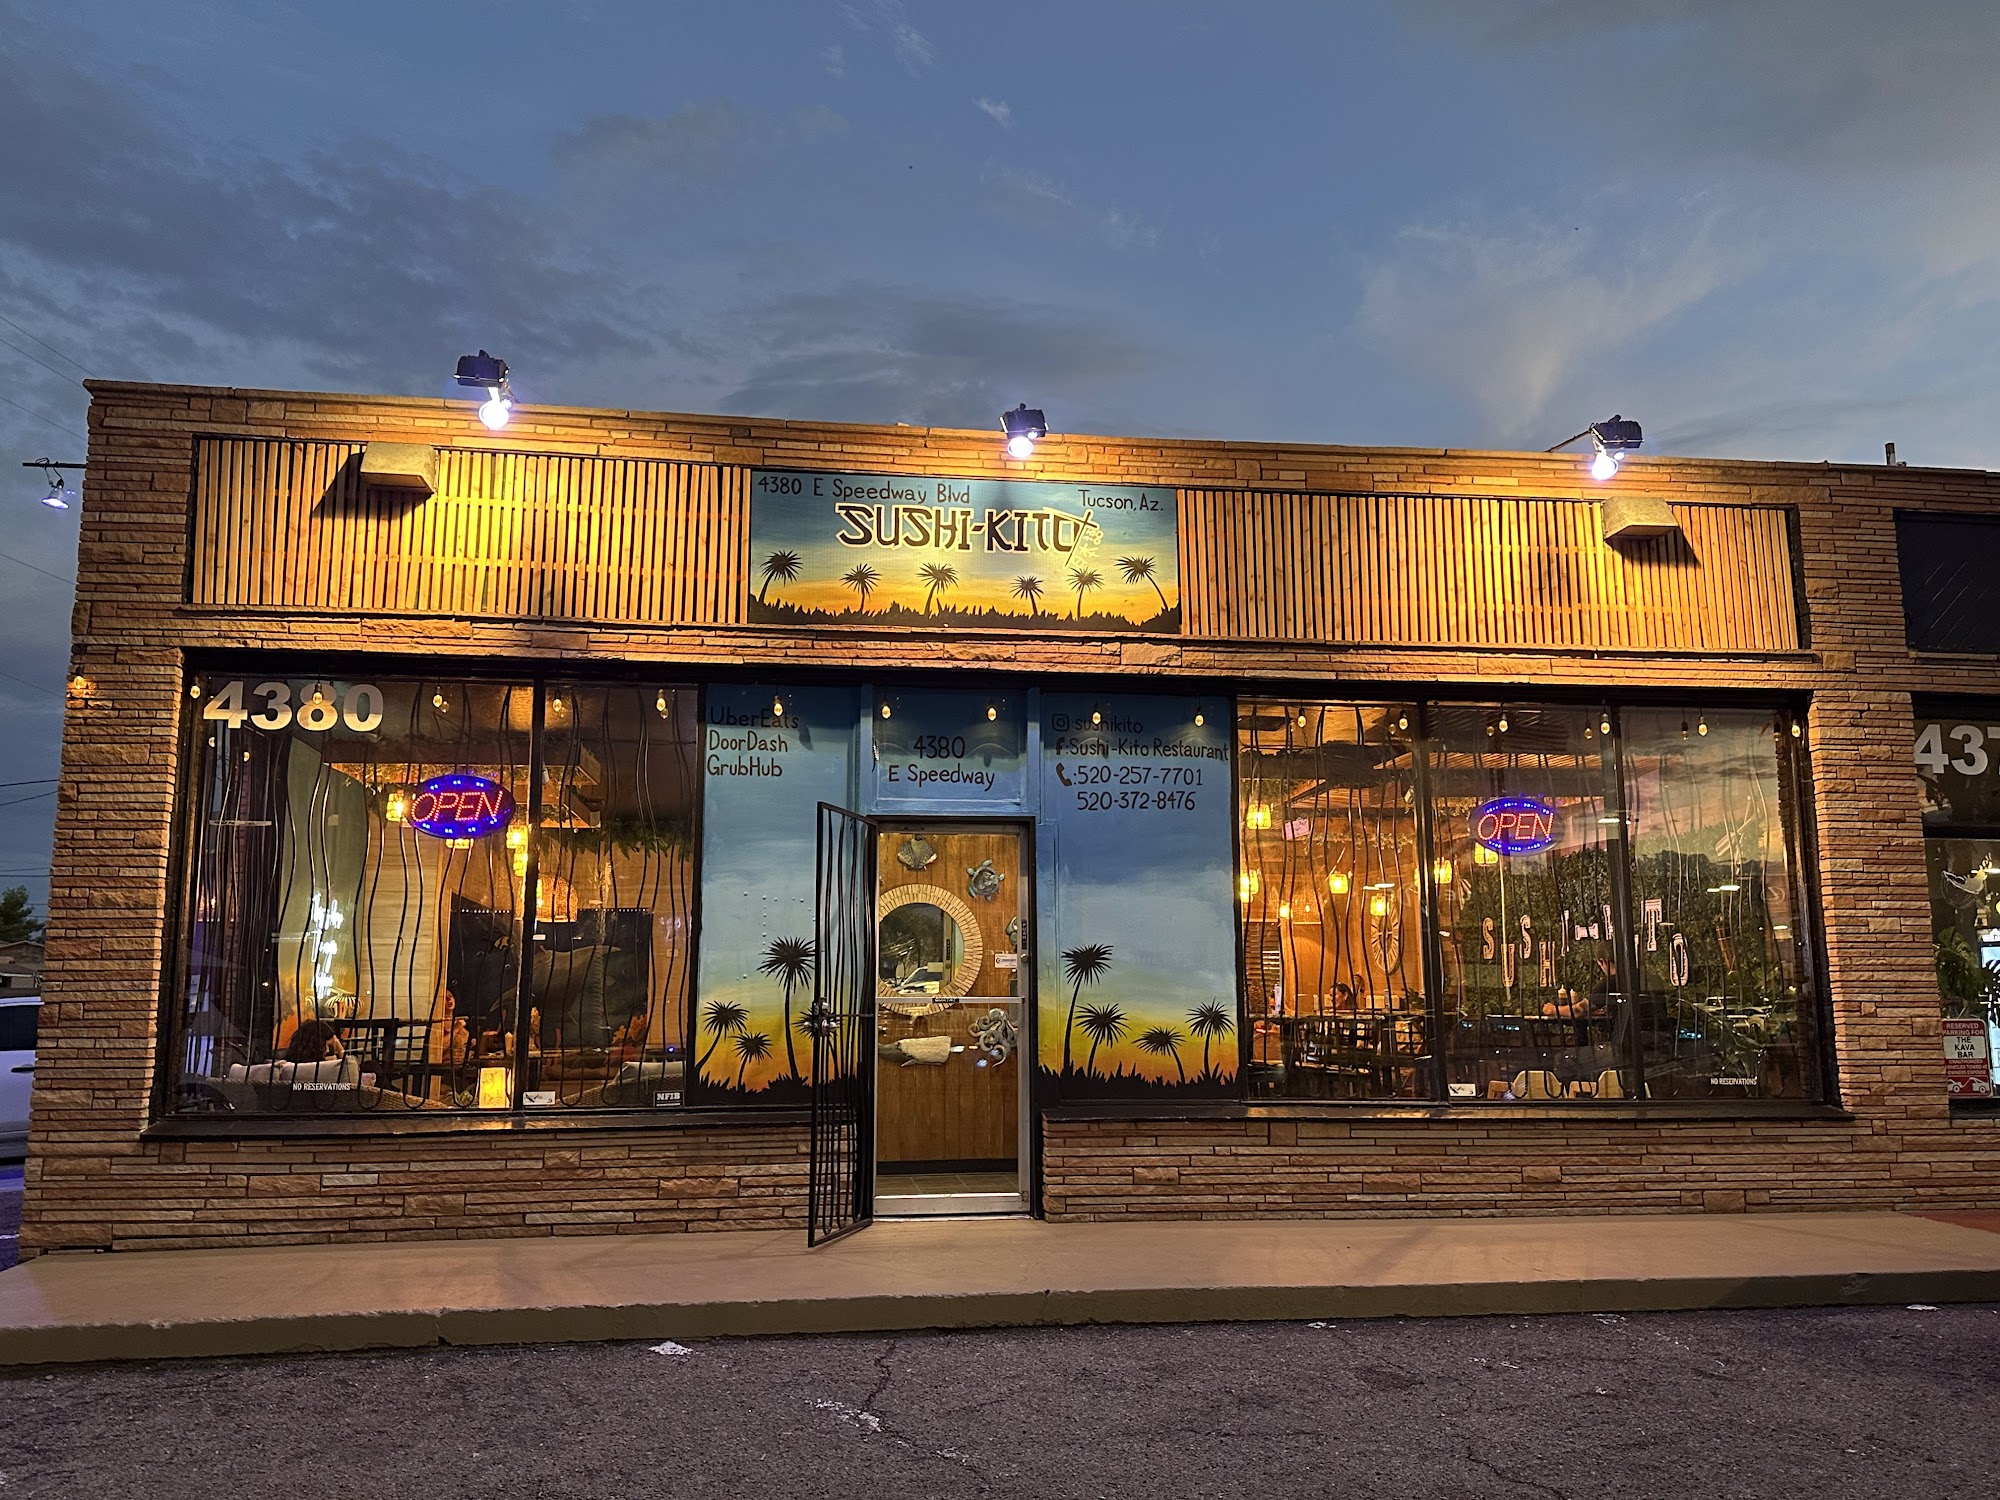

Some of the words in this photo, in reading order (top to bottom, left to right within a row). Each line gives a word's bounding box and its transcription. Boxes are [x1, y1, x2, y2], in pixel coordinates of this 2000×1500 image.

[758, 476, 802, 495] 4380
[814, 478, 824, 496] E
[832, 479, 927, 504] Speedway
[937, 483, 970, 503] Blvd
[1078, 489, 1137, 511] Tucson,
[836, 503, 1083, 553] SUSHI-KITO
[203, 680, 384, 732] 4380
[710, 706, 800, 729] UberEats
[709, 729, 789, 752] DoorDash
[913, 735, 966, 759] 4380
[1153, 738, 1229, 761] Restaurant
[707, 754, 783, 777] GrubHub
[889, 765, 900, 782] E
[907, 762, 995, 792] Speedway
[410, 790, 504, 822] OPEN
[1077, 791, 1196, 810] 520-372-8476
[1477, 812, 1554, 840] OPEN
[292, 1082, 303, 1091] NO
[303, 1082, 351, 1091] RESERVATIONS
[1710, 1077, 1719, 1085] NO
[1719, 1077, 1757, 1086] RESERVATIONS
[656, 1092, 681, 1101] NFIB
